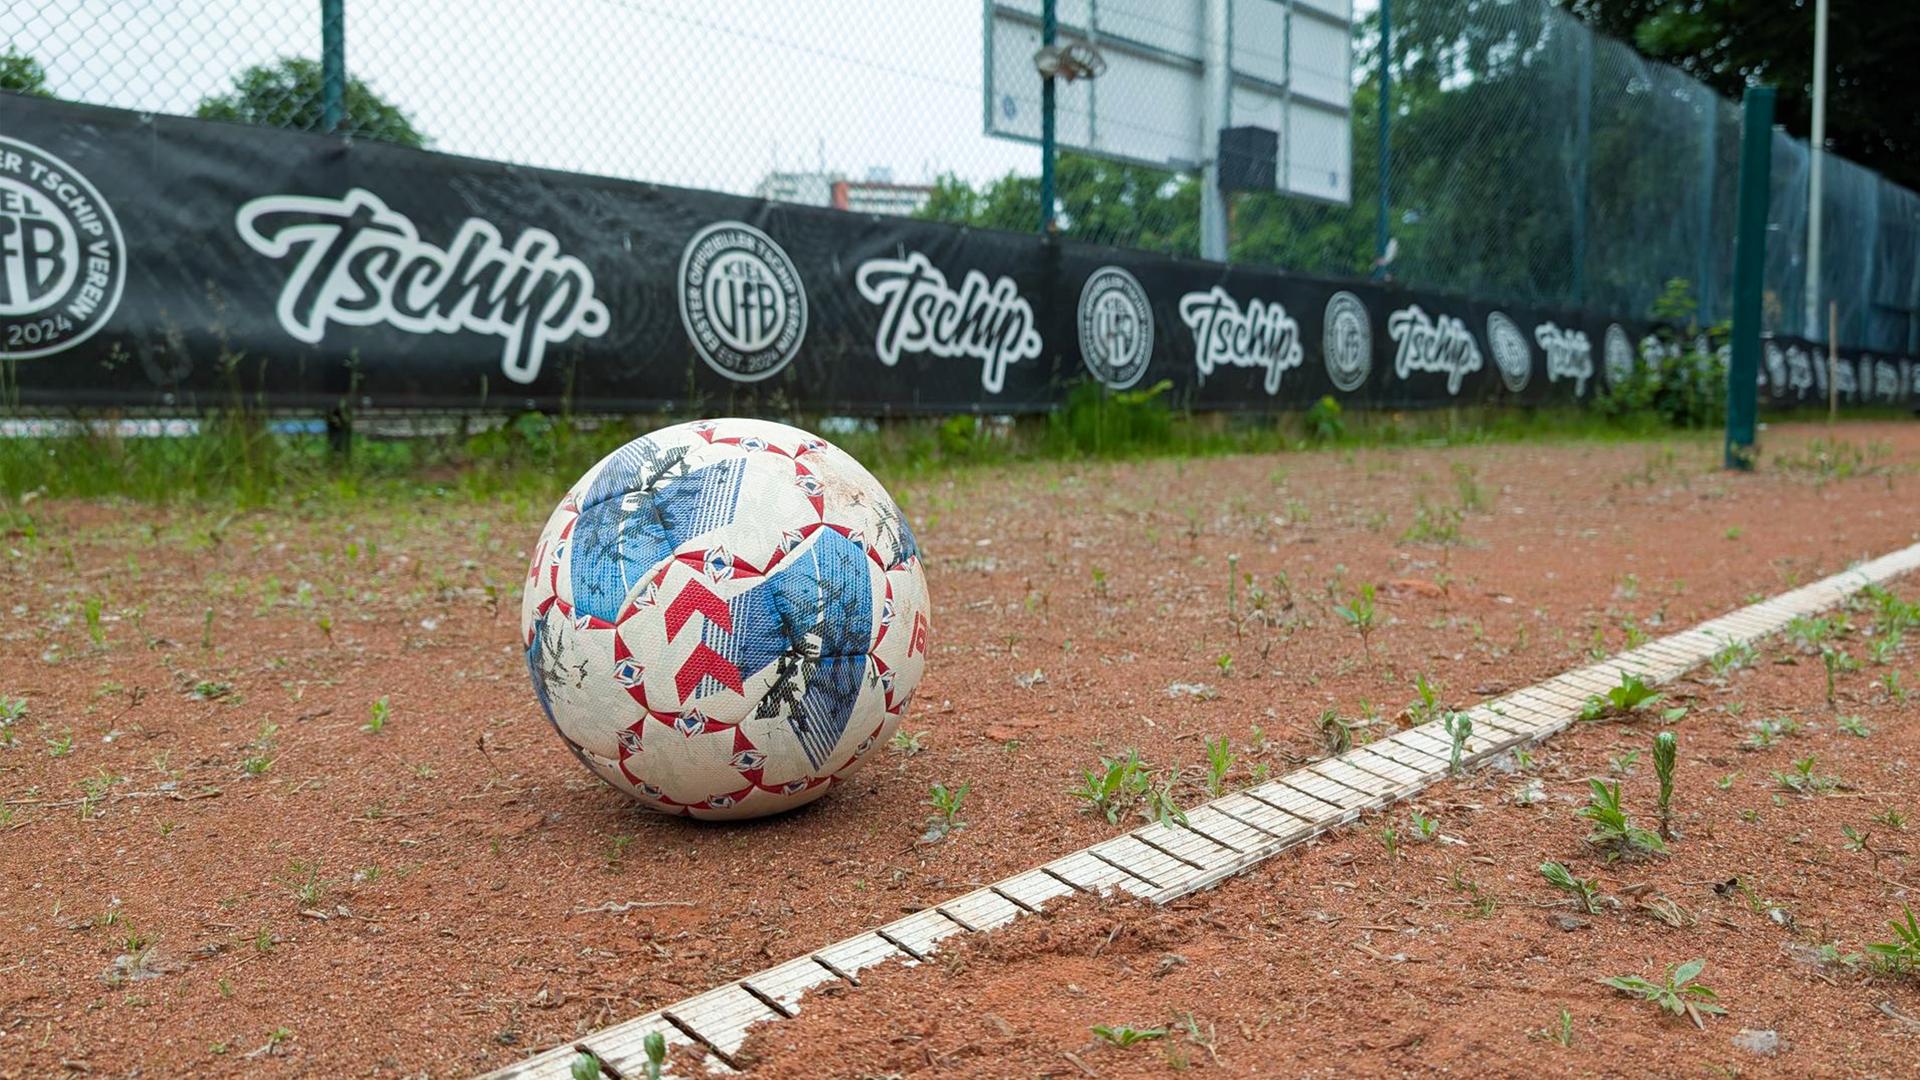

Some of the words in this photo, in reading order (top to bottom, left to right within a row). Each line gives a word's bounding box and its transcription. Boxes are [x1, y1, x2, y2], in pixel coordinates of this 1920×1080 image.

[0, 187, 42, 214] EL
[30, 160, 103, 237] TSCHIP
[68, 240, 111, 321] VEREIN
[0, 214, 66, 305] fB
[236, 188, 610, 384] Tschip.
[8, 313, 73, 345] 2024
[688, 286, 720, 352] ERSTER
[856, 252, 1042, 393] Tschip.
[1179, 285, 1303, 394] Tschip.
